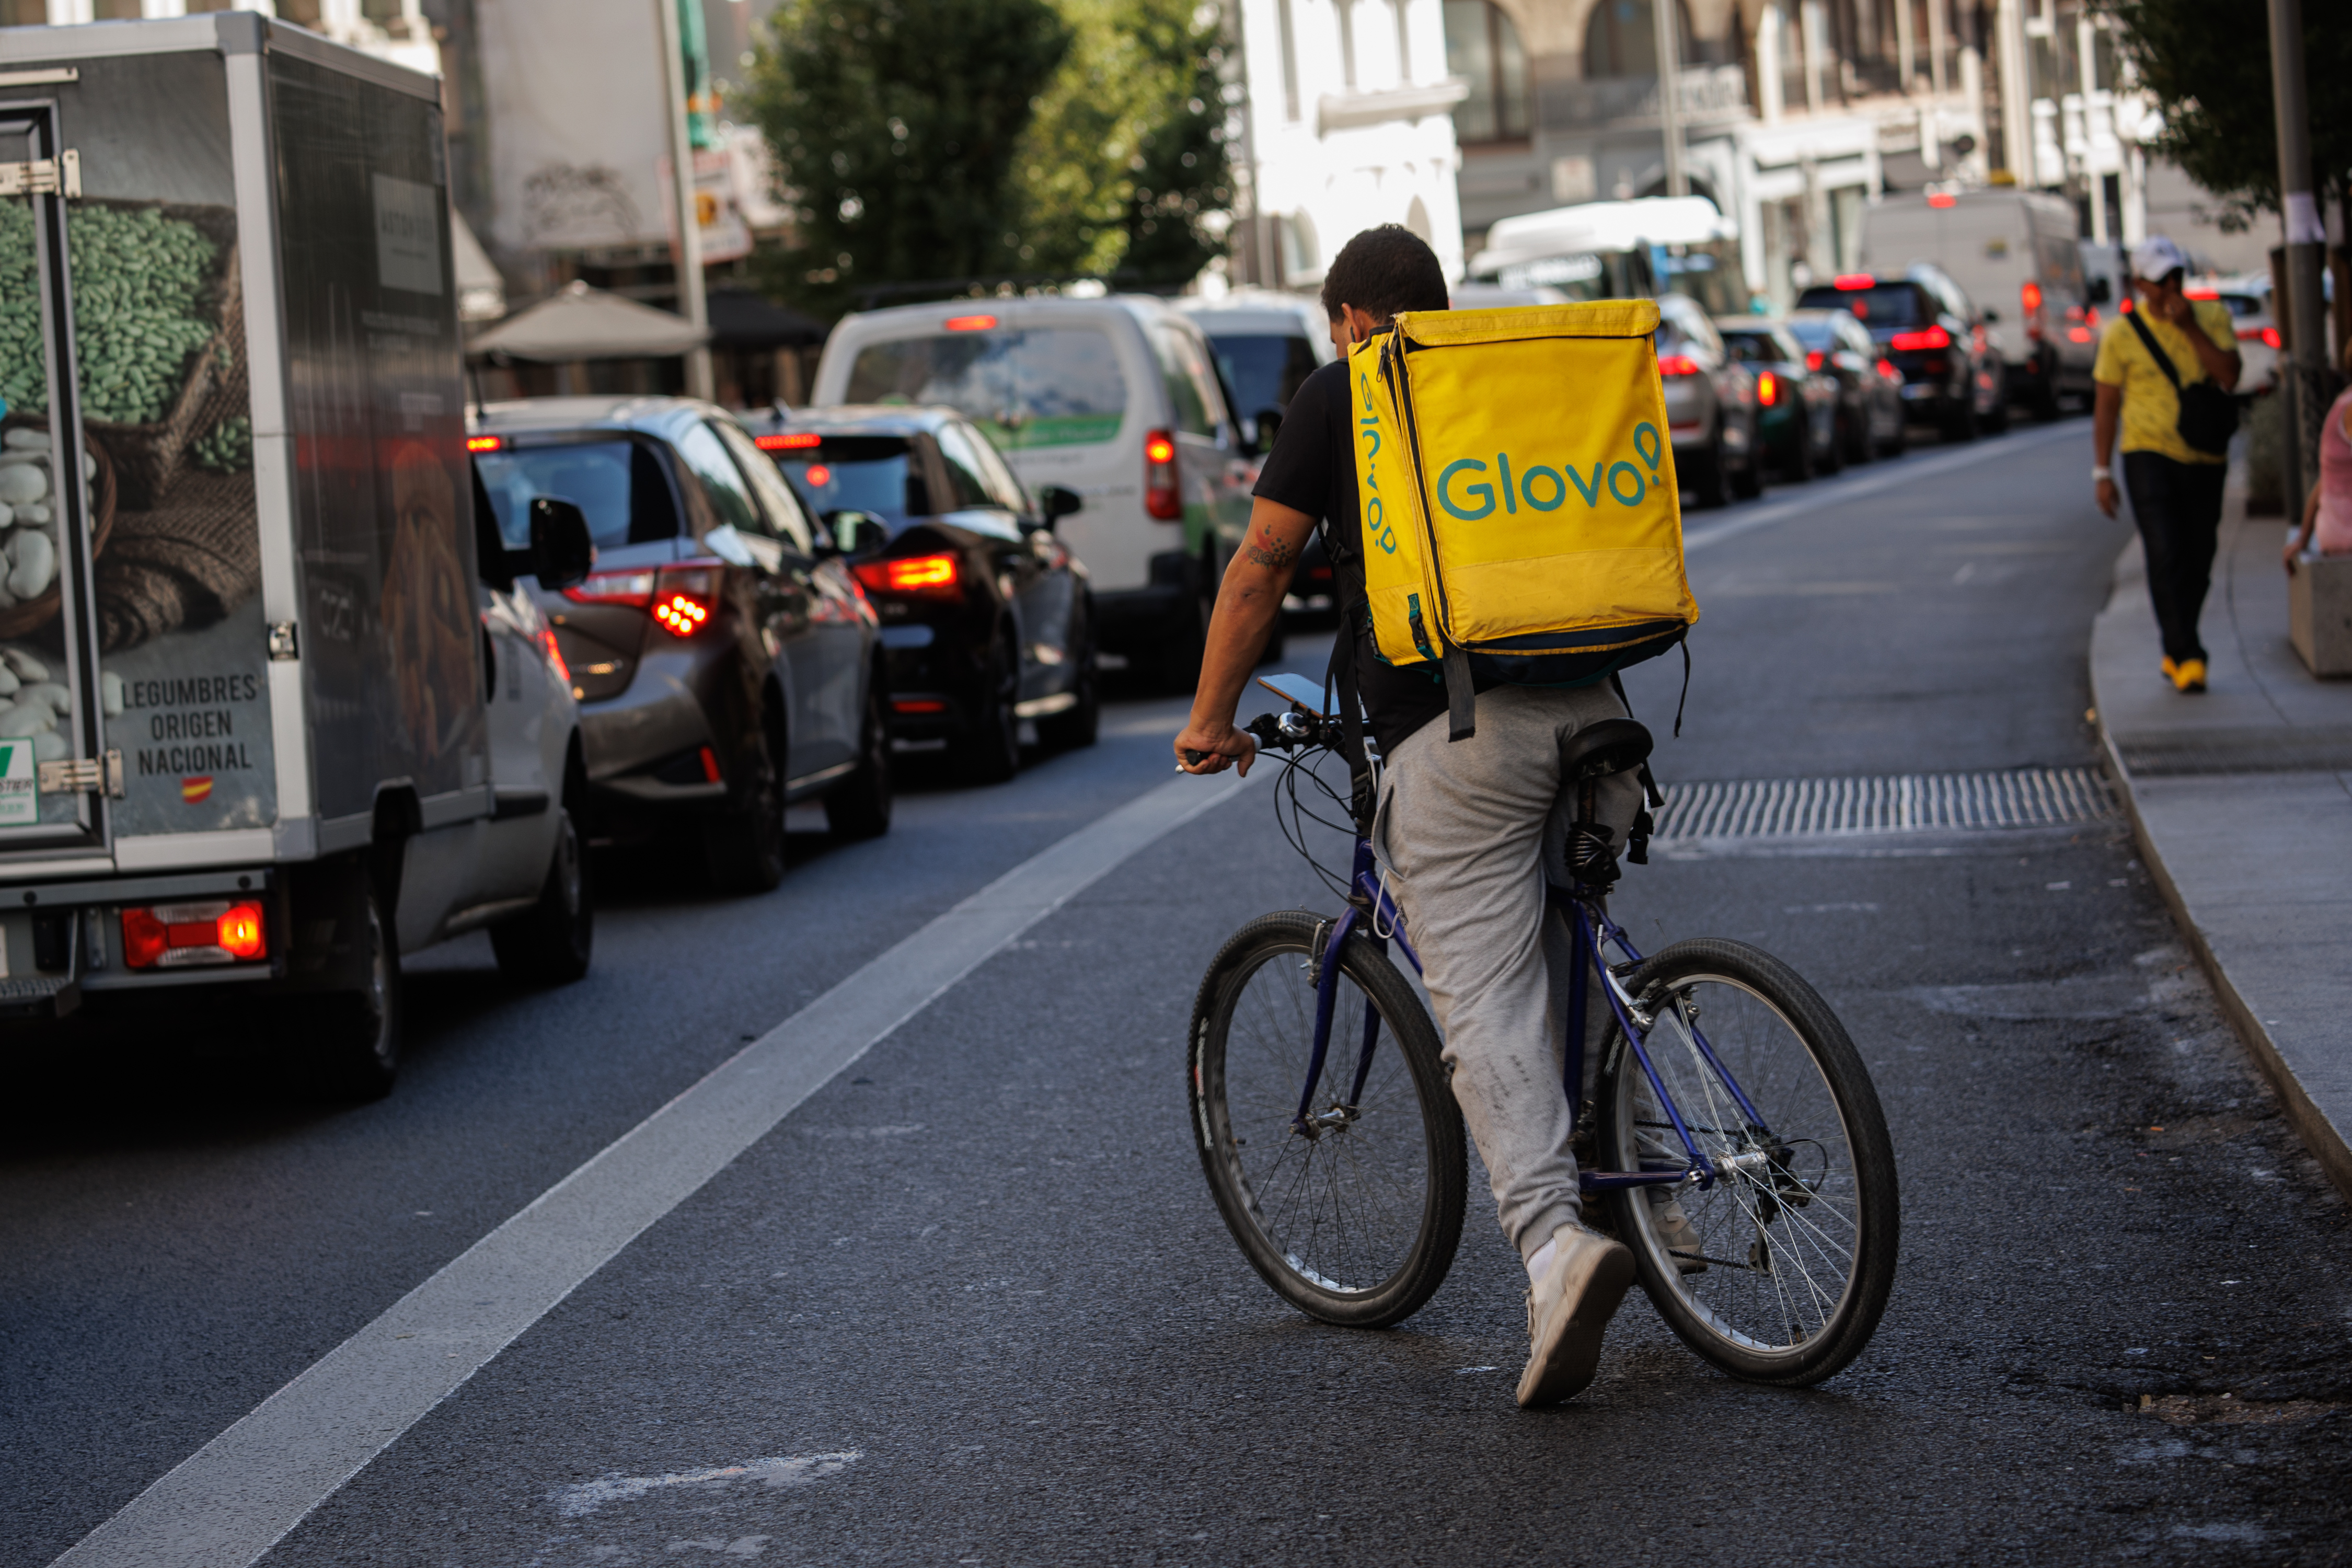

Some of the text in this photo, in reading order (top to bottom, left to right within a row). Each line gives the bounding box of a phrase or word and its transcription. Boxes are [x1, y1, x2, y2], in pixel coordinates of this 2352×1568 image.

[121, 674, 256, 709] LEGUMBRES
[151, 709, 233, 741] ORIGEN
[139, 742, 251, 775] NACIONAL
